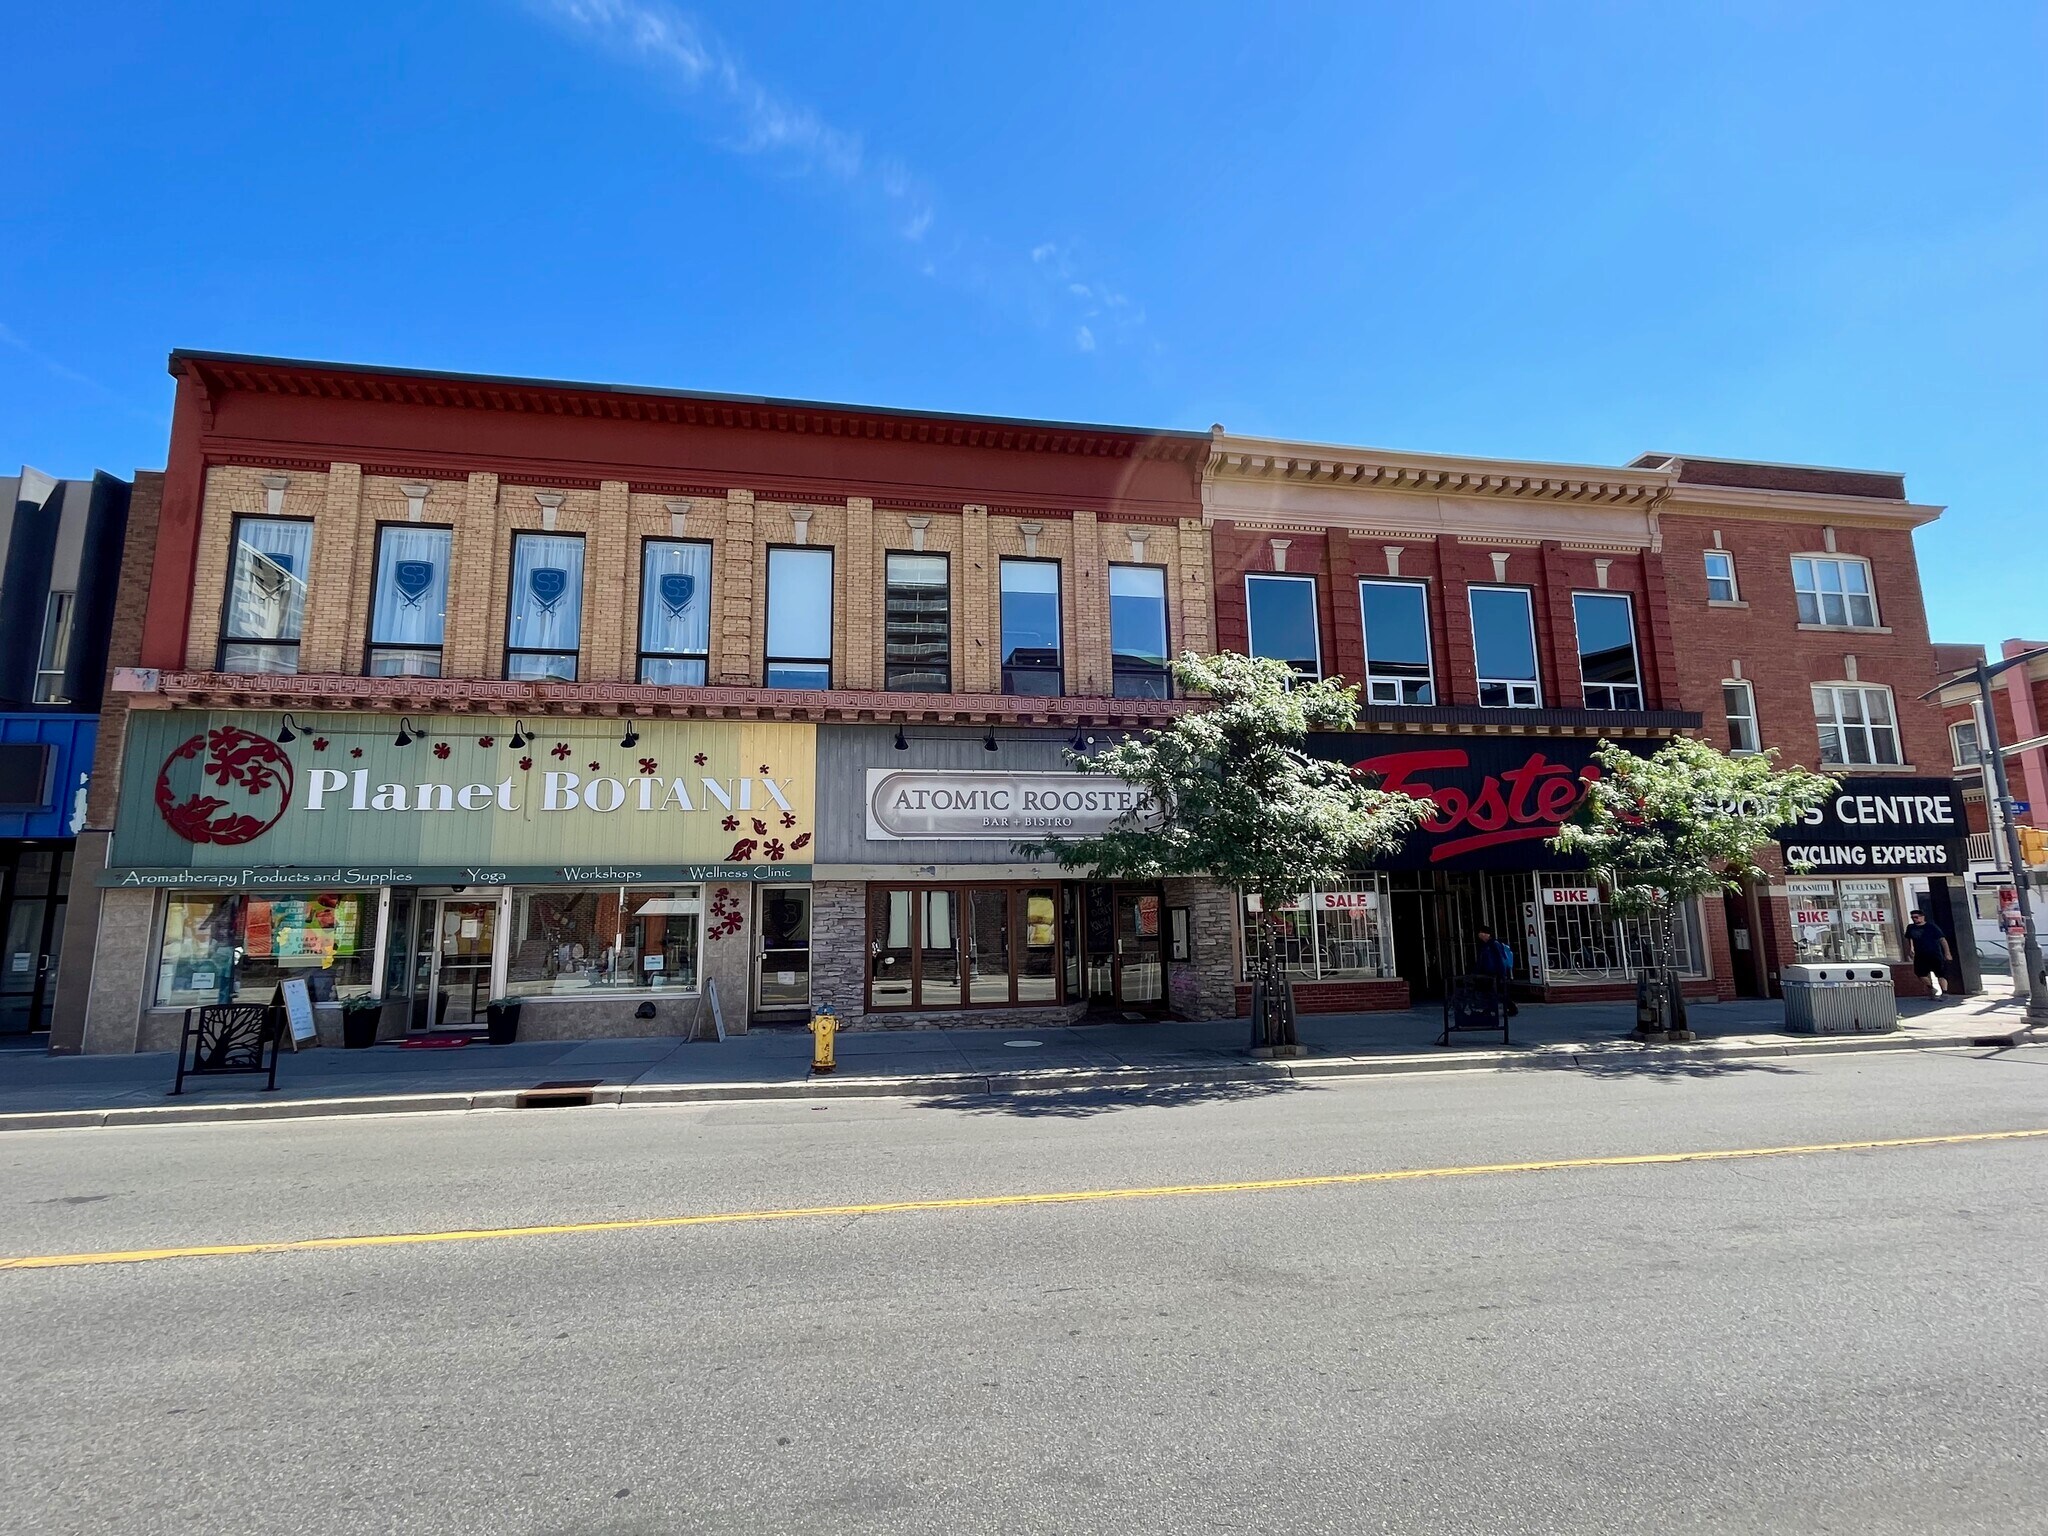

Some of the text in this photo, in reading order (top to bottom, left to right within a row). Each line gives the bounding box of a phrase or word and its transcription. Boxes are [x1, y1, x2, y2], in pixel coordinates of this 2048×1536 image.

[304, 768, 795, 813] Planet BOTANIX
[893, 789, 1155, 812] ATOMIC ROOSTER
[1835, 795, 1954, 824] CENTRE
[982, 817, 1009, 827] BAR
[1025, 817, 1072, 828] BISTRO
[1786, 845, 1947, 865] CYCLING EXPERTS
[122, 867, 413, 887] Aromatherapy Products and Supplies
[467, 868, 507, 885] Yoga
[563, 866, 643, 882] Workshops
[689, 865, 792, 880] Wellness Clinic
[1788, 883, 1830, 892] LOCKSMITH
[1324, 894, 1367, 907] SALE
[1553, 890, 1589, 902] BIKE
[1797, 911, 1830, 923] BIKE
[1851, 910, 1885, 922] SALE
